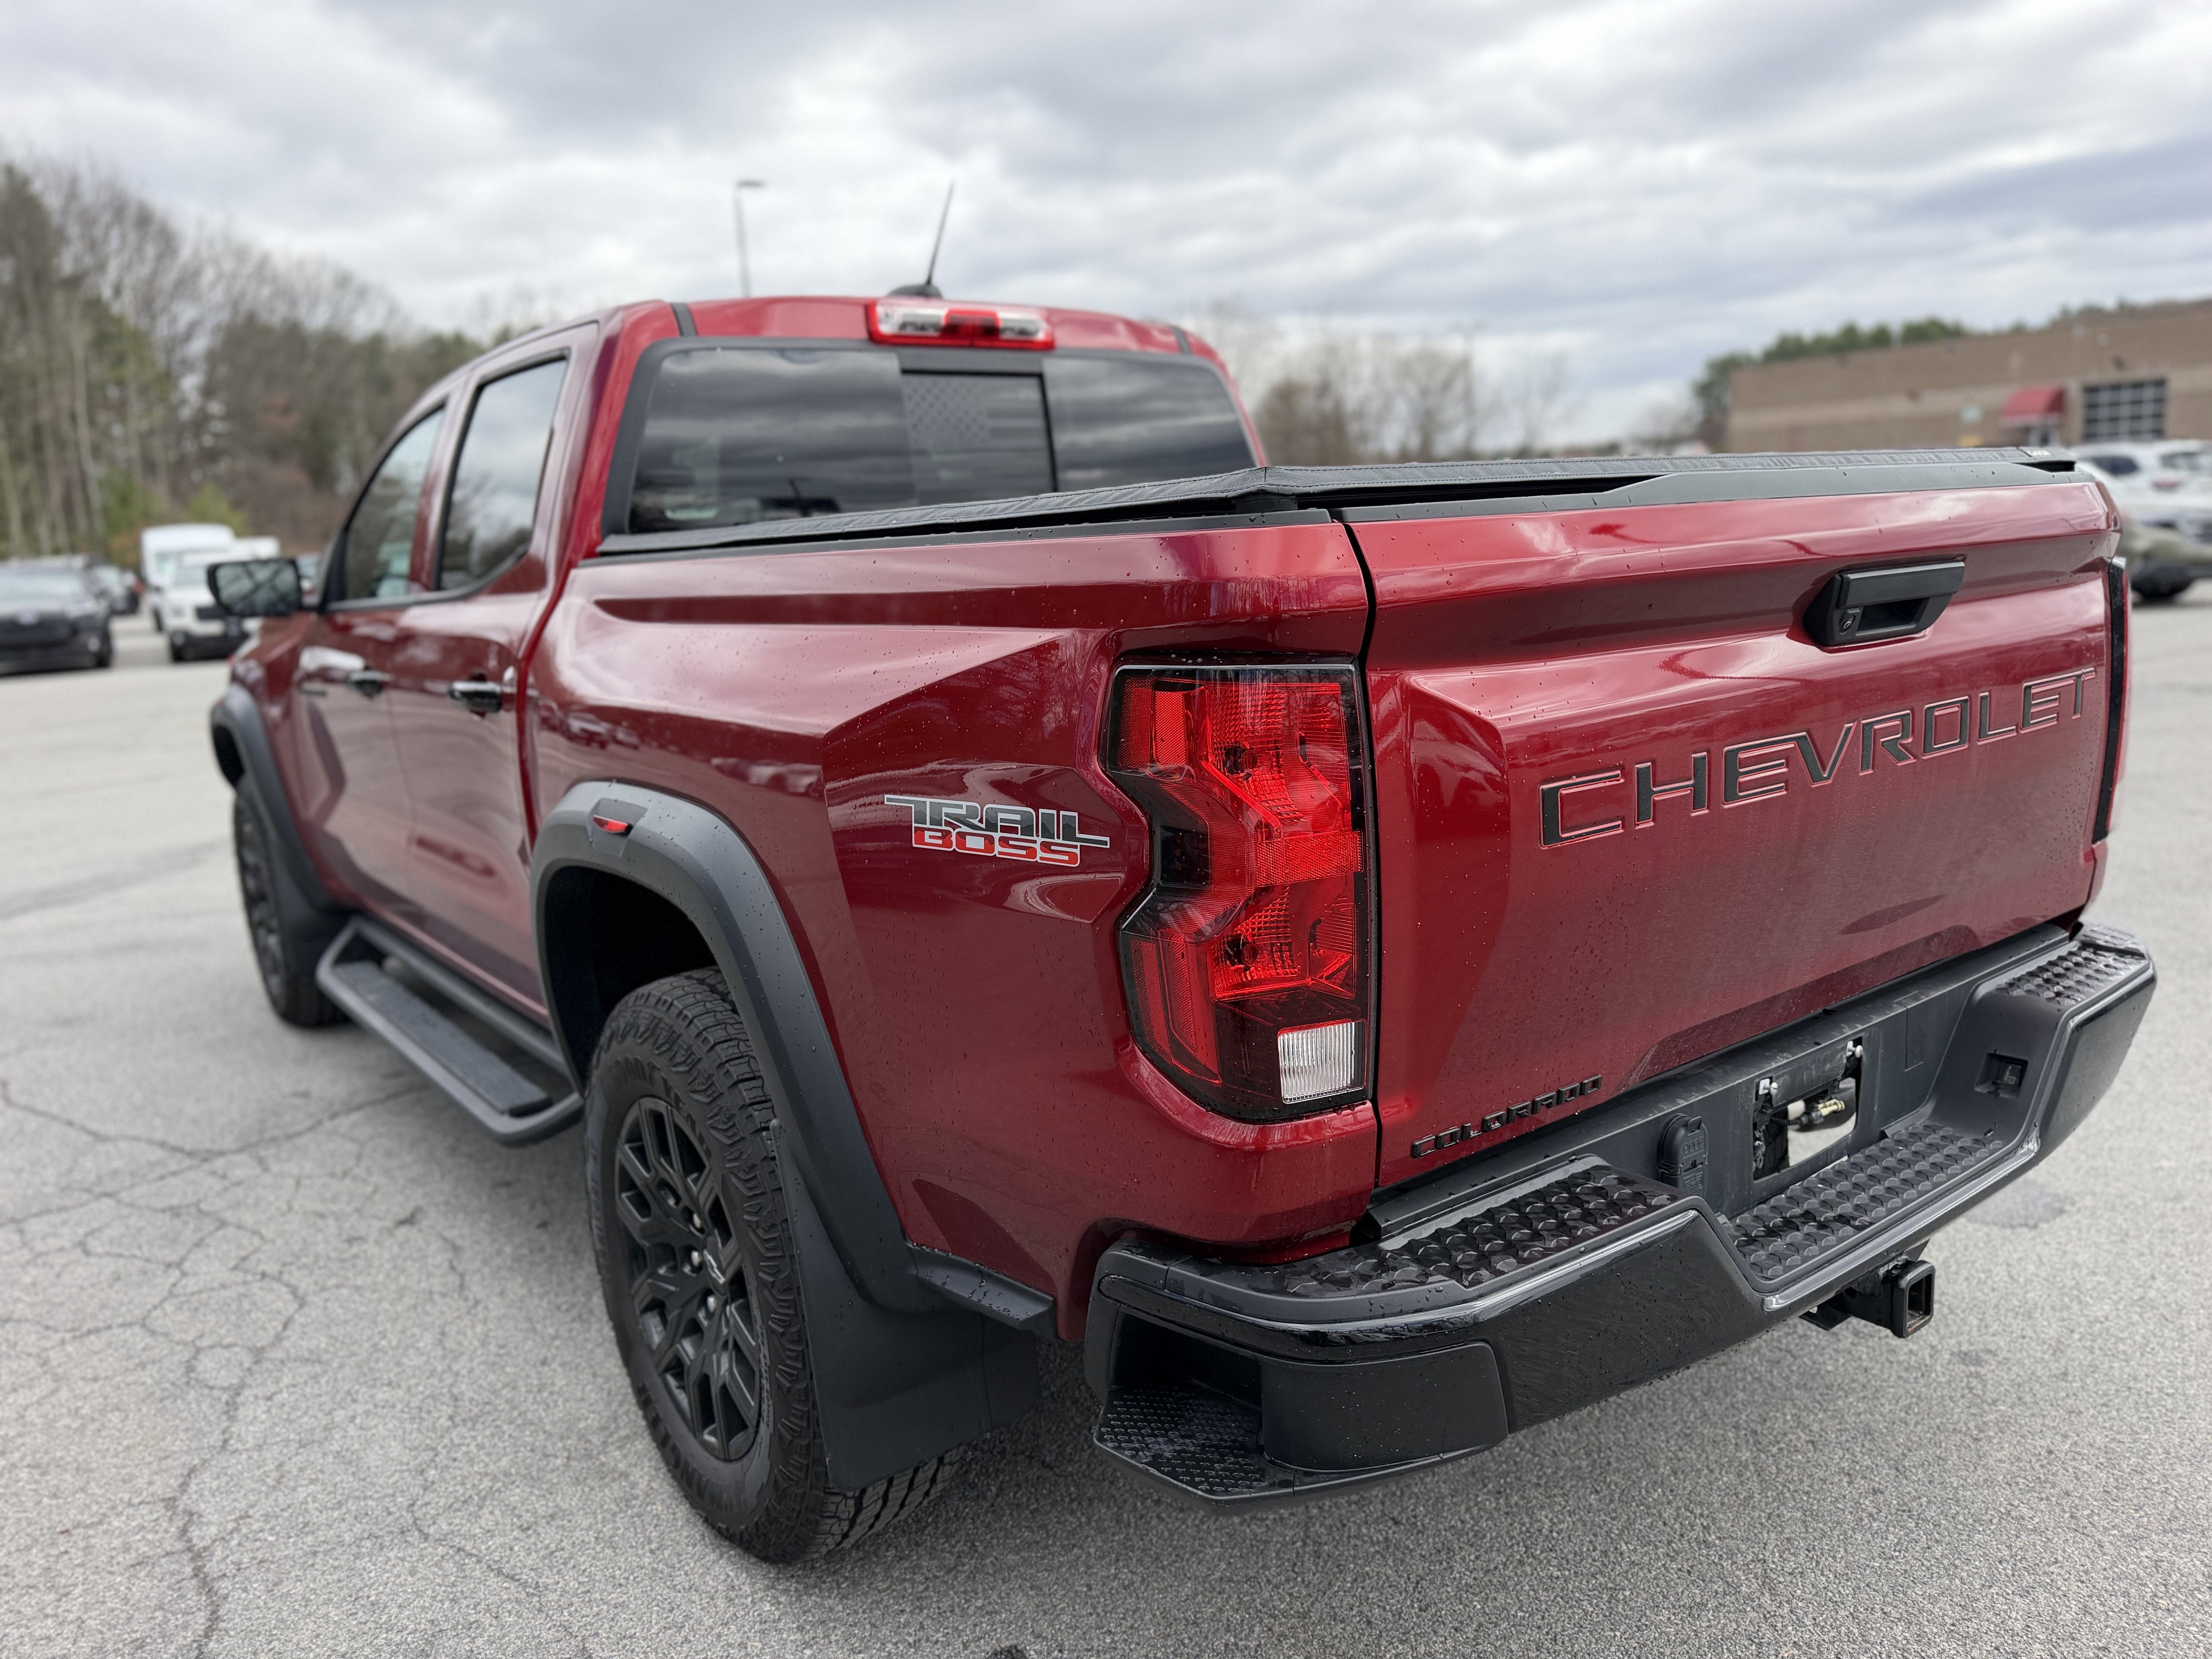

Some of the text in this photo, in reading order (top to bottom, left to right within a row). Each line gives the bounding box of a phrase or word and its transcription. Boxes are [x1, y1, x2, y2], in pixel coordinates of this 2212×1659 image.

[1539, 668, 2095, 849] CHEVROLET
[884, 794, 1110, 848] TRAIL
[912, 826, 1080, 867] BOSS
[1411, 1074, 1602, 1158] COLORADO
